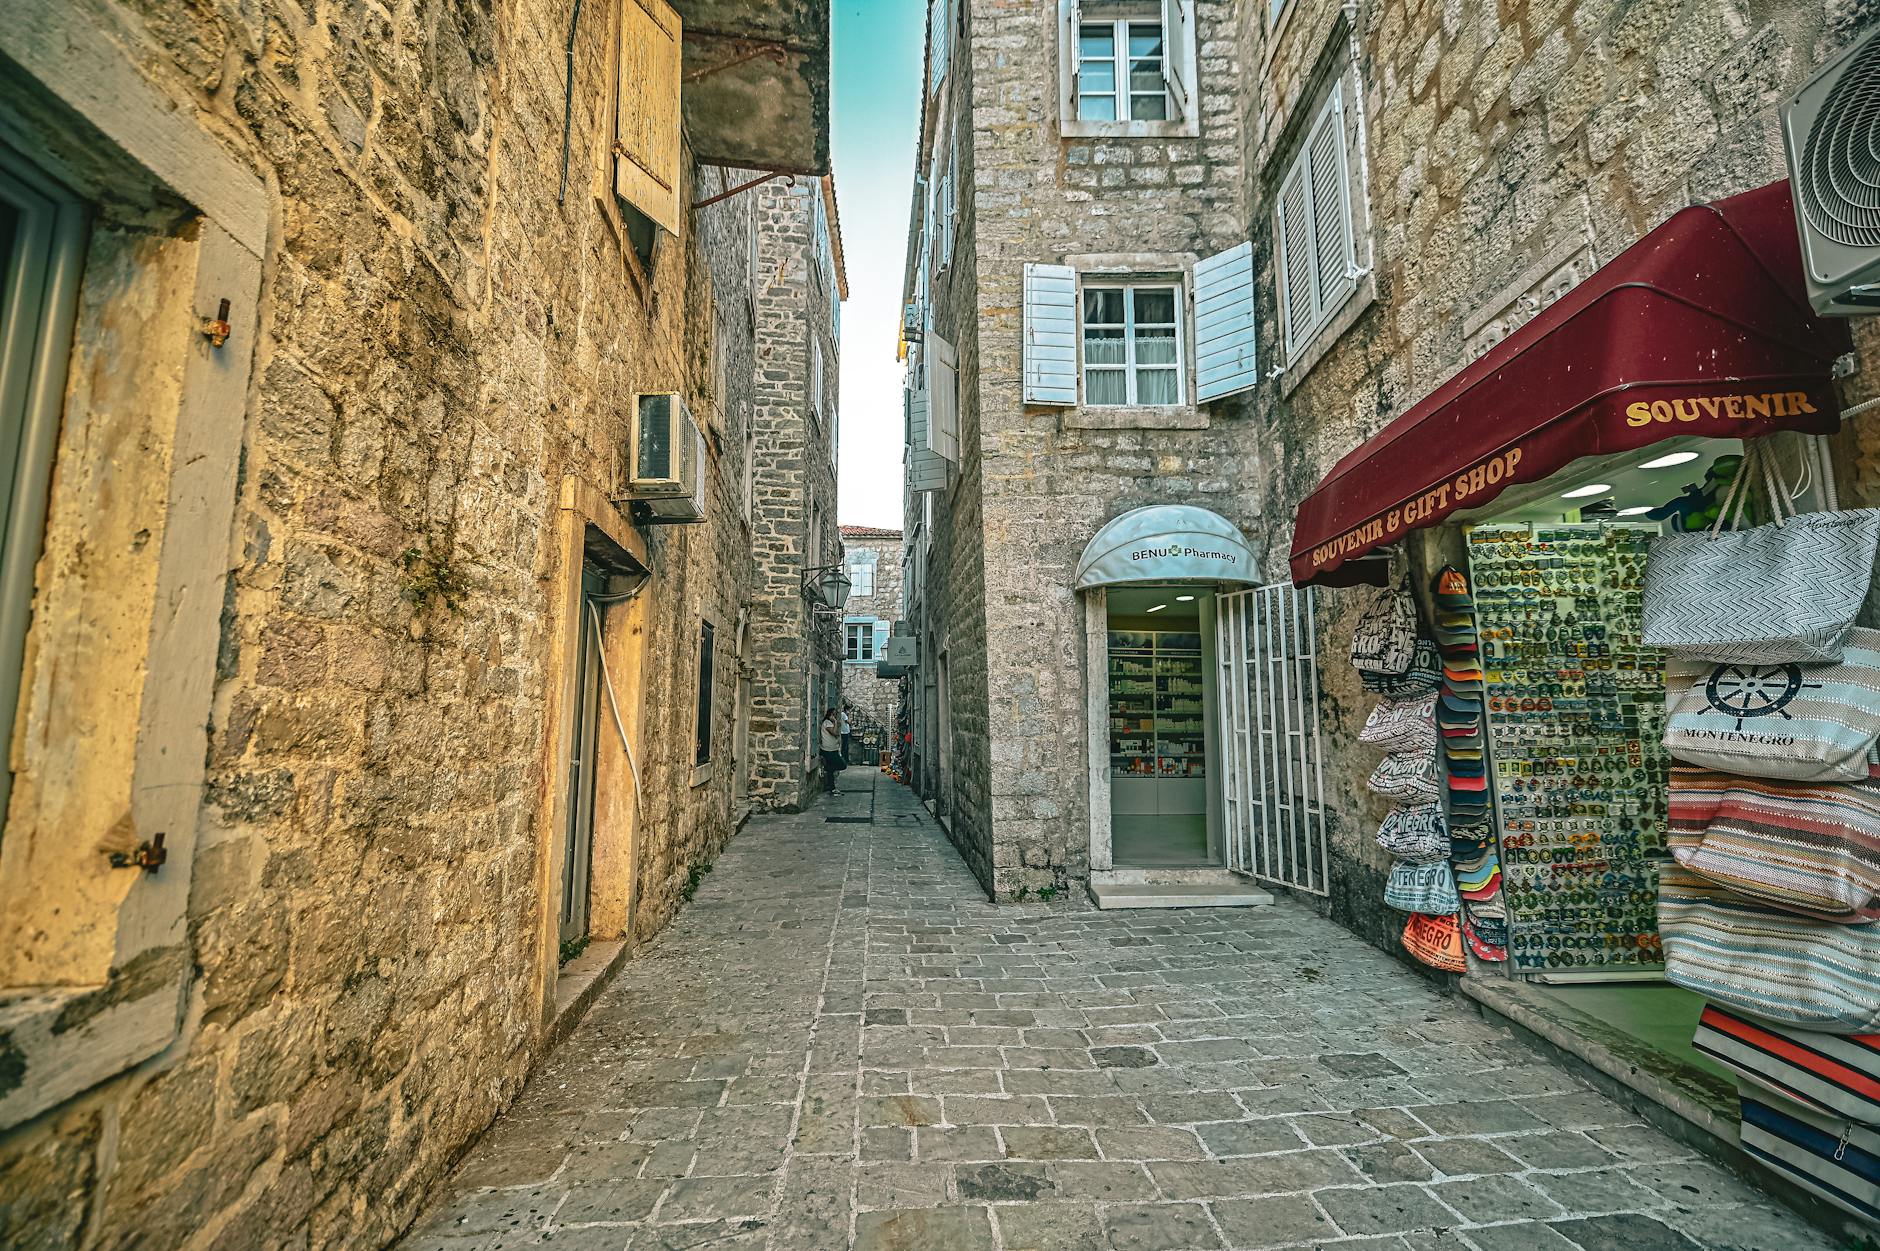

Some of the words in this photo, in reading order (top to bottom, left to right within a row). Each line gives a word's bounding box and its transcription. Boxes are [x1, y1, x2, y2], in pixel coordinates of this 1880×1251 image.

[1625, 391, 1818, 427] SOUVENIR
[1312, 518, 1384, 567] SOUVENIR
[1386, 510, 1400, 533] &
[1403, 482, 1451, 524] GIFT
[1454, 447, 1522, 501] SHOP
[1132, 548, 1167, 561] BENU
[1184, 548, 1236, 563] Pharmacy
[1683, 728, 1795, 747] MONTENEGRO
